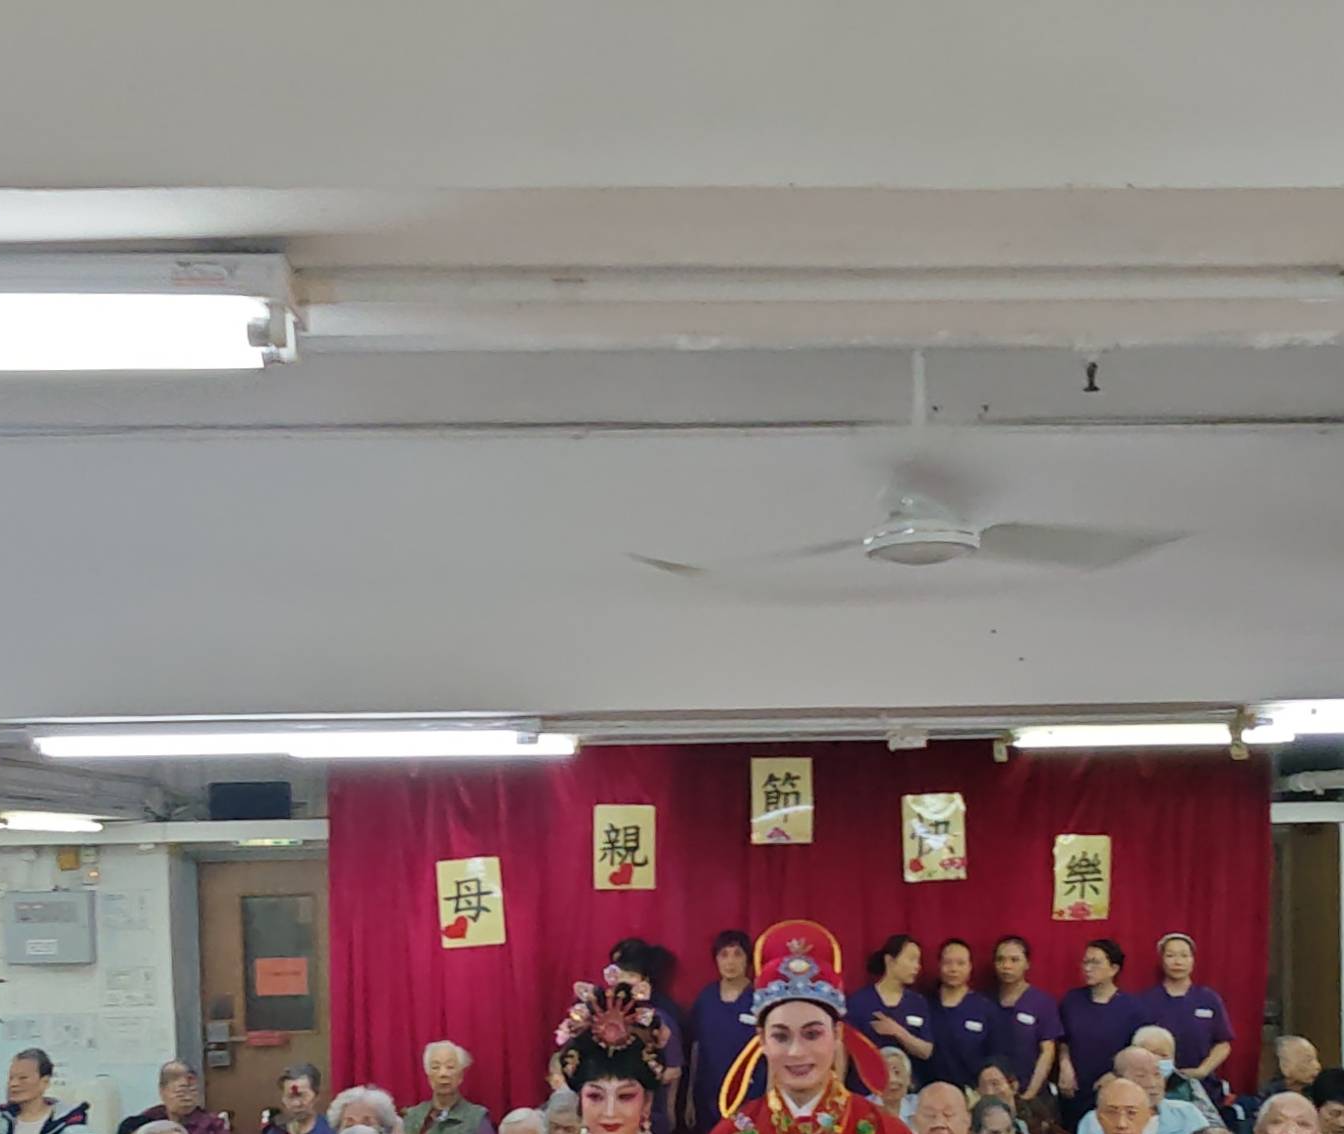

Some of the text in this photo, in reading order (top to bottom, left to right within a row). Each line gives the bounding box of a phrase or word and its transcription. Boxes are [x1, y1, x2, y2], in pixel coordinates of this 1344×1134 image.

[444, 878, 493, 923] 母
[599, 823, 649, 867] 親
[763, 772, 802, 823] 節
[1064, 853, 1105, 899] 樂
